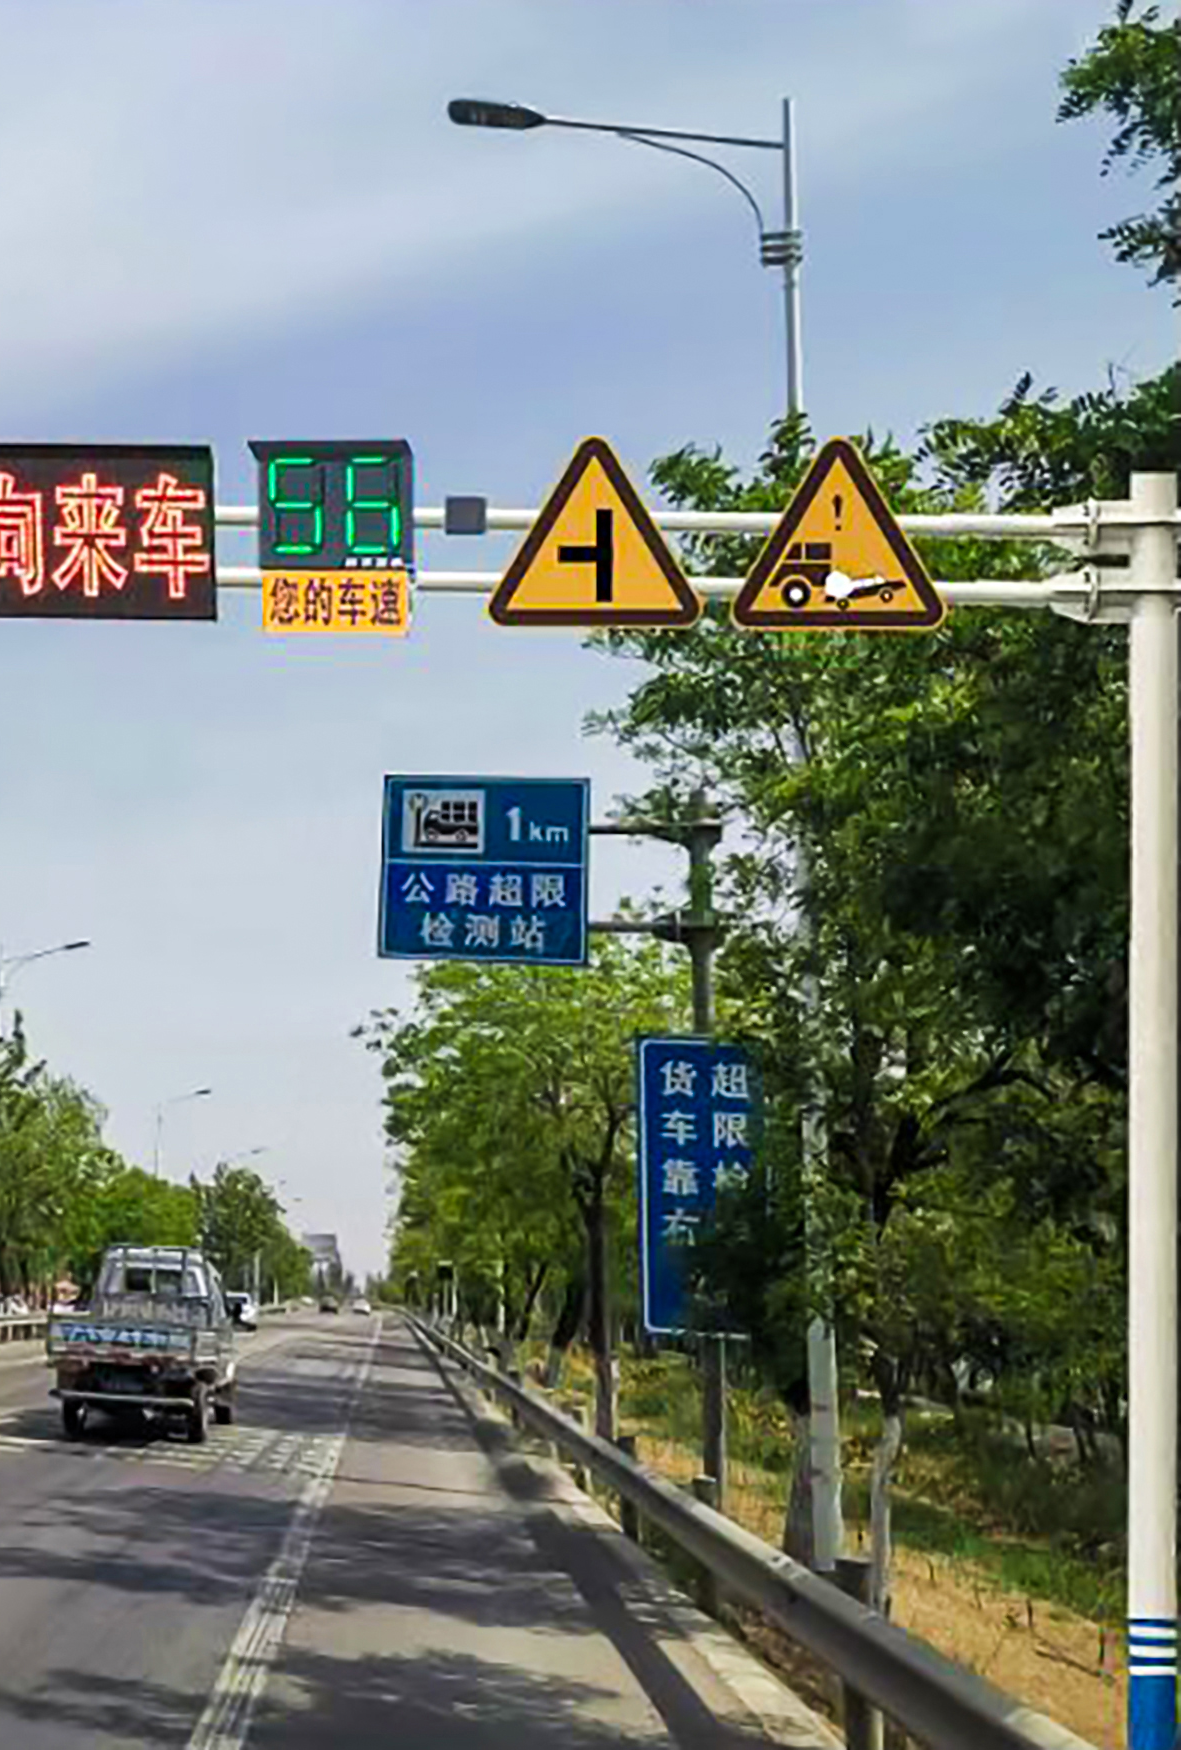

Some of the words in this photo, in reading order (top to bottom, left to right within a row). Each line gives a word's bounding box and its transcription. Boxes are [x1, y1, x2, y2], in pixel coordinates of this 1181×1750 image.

[268, 456, 401, 555] 56
[269, 577, 402, 626] 您的车速
[401, 872, 567, 908] 公路超限
[420, 911, 547, 952] 检测站
